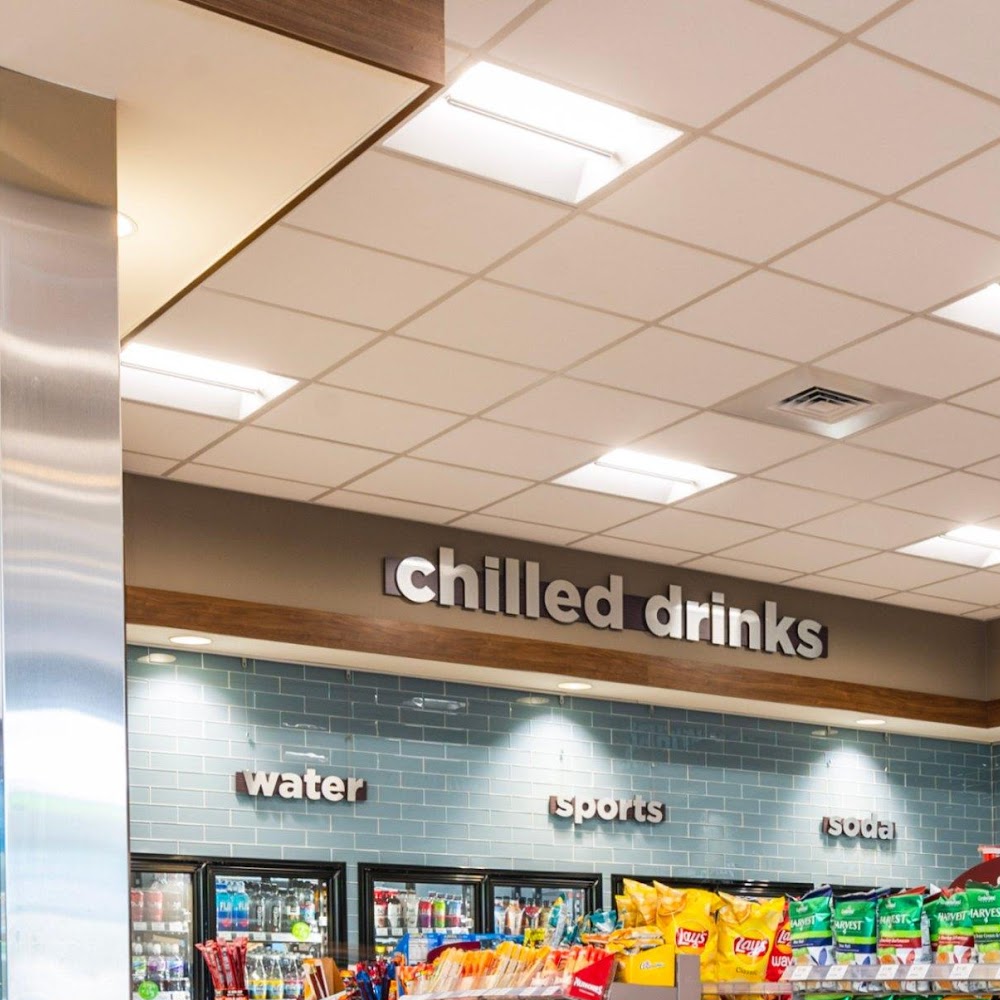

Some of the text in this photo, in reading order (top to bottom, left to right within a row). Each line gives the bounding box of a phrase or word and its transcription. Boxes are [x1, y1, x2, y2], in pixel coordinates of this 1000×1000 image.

[396, 546, 823, 659] chilled drinks
[244, 767, 364, 802] water
[555, 795, 664, 825] sports
[828, 812, 895, 841] soda
